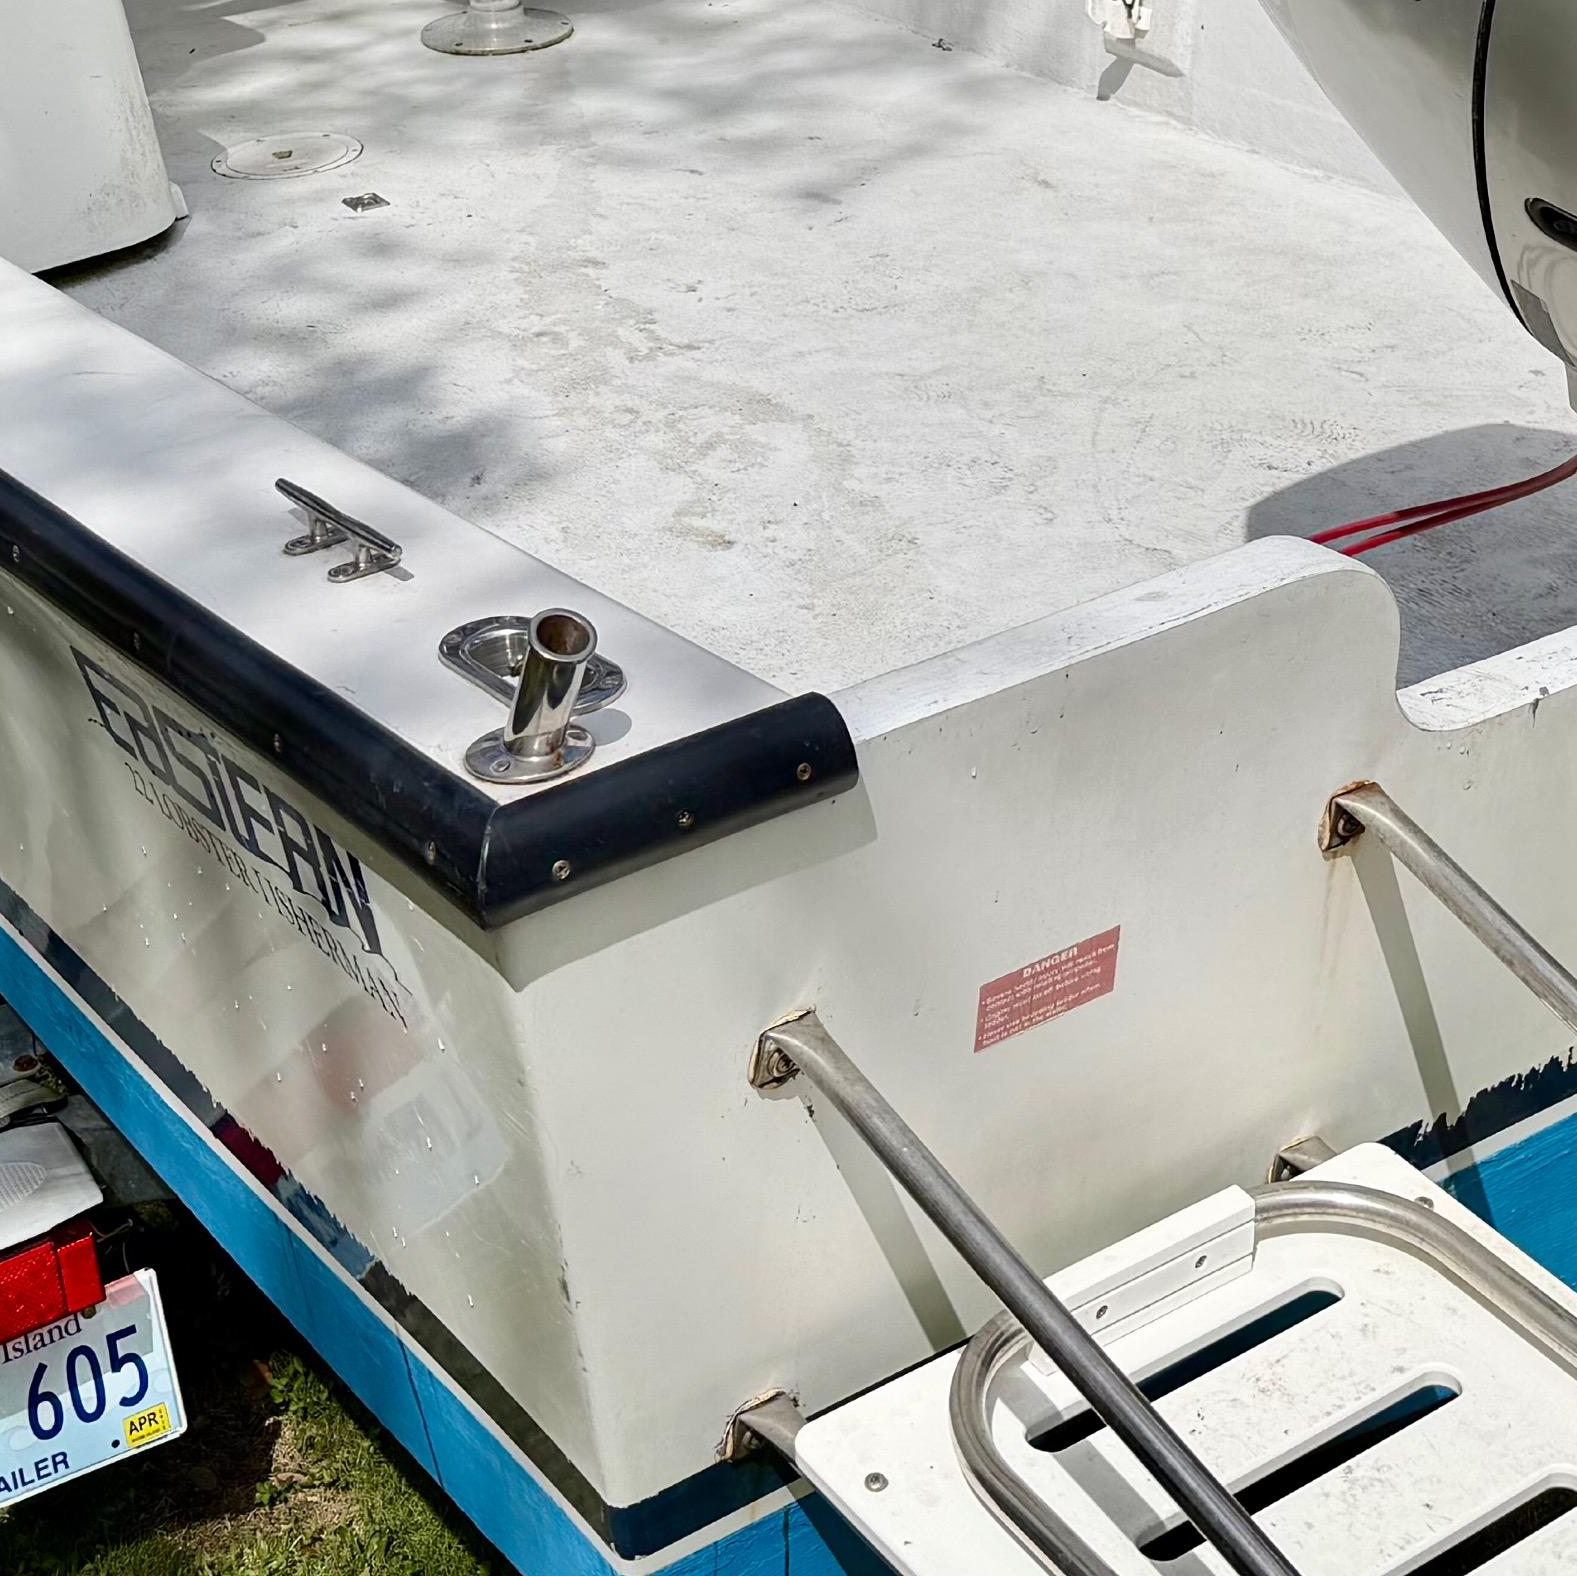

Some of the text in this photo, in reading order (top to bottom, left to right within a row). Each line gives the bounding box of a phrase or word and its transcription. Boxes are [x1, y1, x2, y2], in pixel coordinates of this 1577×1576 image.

[150, 782, 258, 894] LOBSTER
[2, 1312, 82, 1363] Island
[28, 1324, 149, 1440] 605
[129, 1412, 159, 1435] APR
